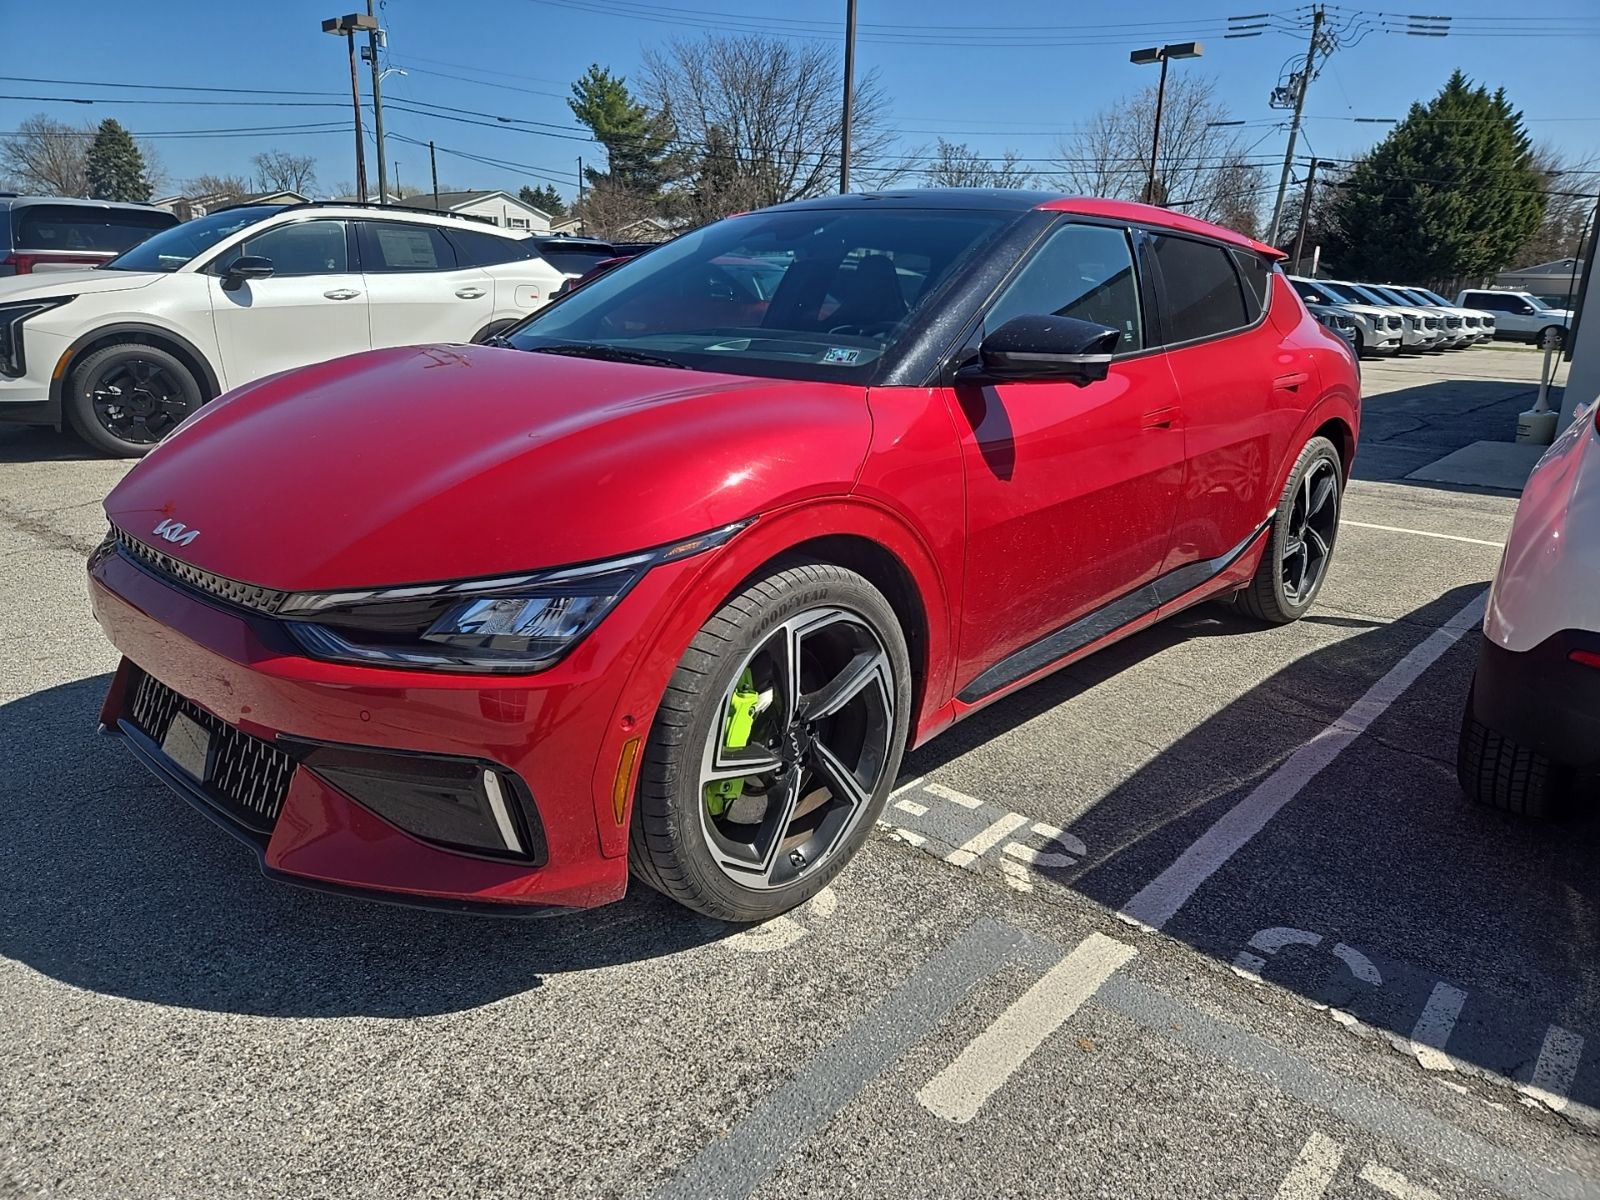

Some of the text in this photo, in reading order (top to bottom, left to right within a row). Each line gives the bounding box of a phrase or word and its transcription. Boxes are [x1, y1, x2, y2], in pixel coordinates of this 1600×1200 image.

[846, 351, 858, 361] 12
[153, 518, 201, 547] KIA
[751, 588, 830, 640] GOODYEAR
